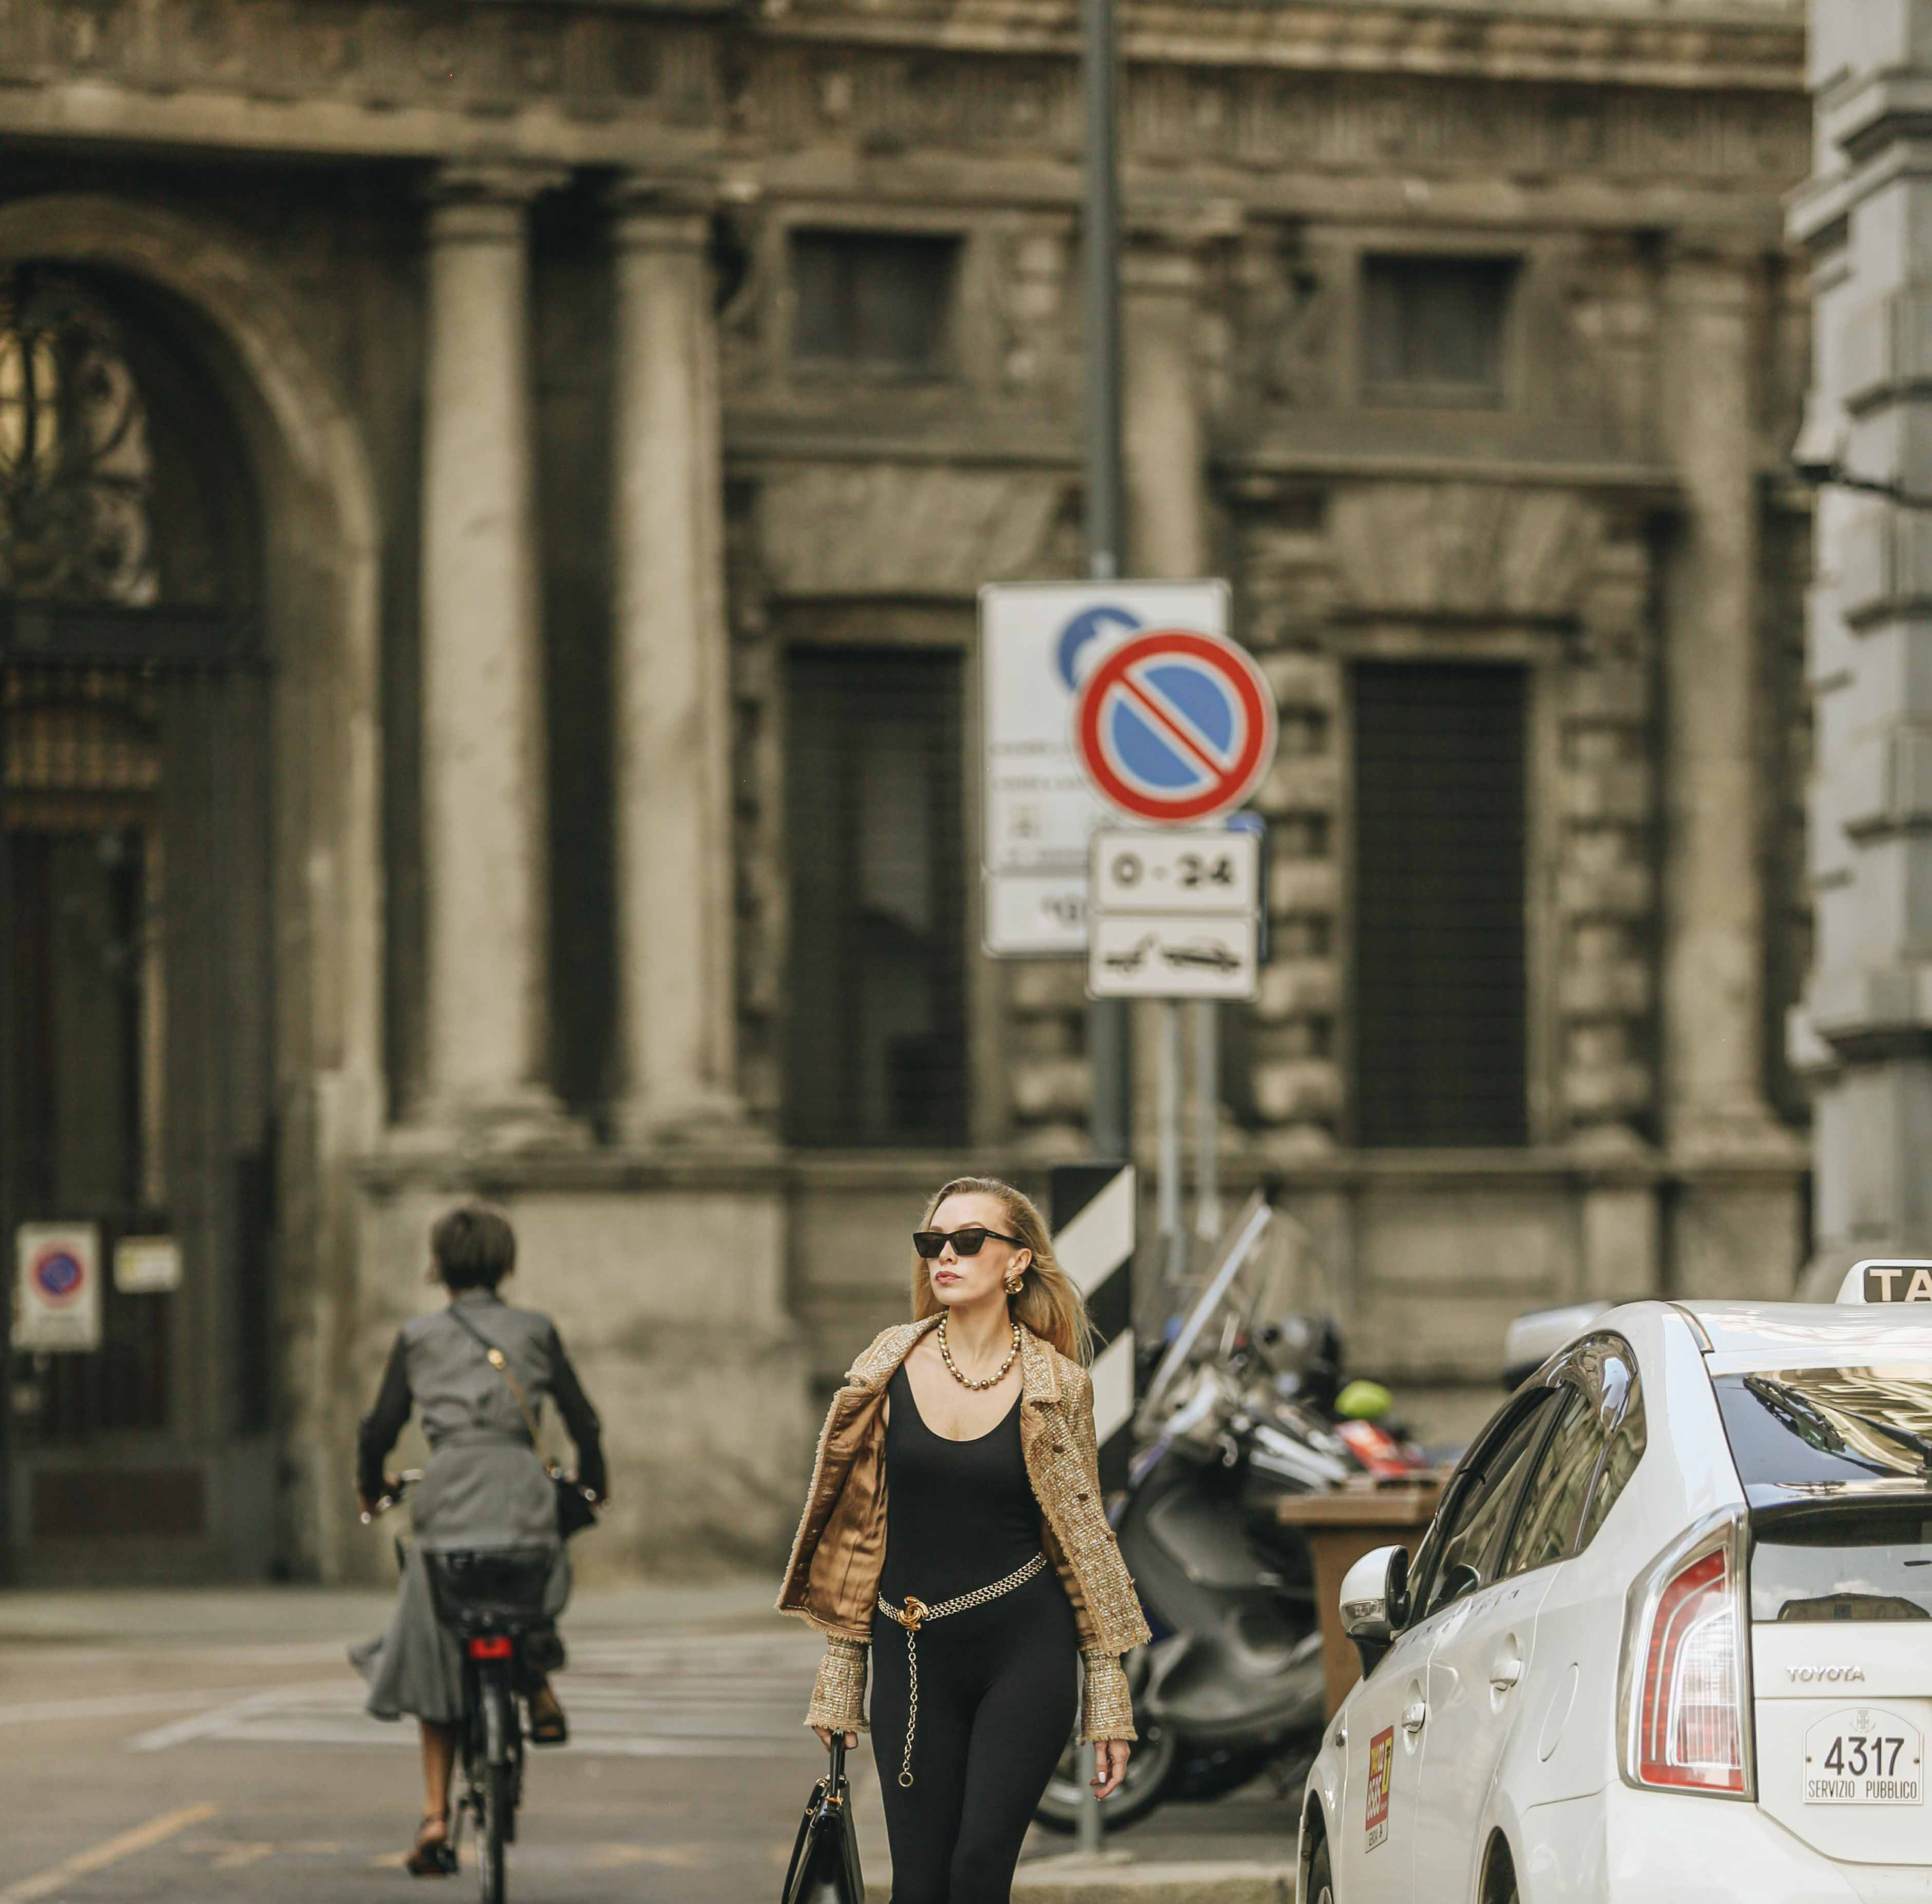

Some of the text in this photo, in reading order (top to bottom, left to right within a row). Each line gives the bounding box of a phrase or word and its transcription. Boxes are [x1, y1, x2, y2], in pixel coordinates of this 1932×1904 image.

[1175, 851, 1236, 890] 24
[1869, 1269, 1932, 1303] TA
[1786, 1666, 1866, 1682] TOYOTA
[1824, 1736, 1905, 1776] 4317
[1808, 1779, 1917, 1799] SERVIZIO PUBBLICO
